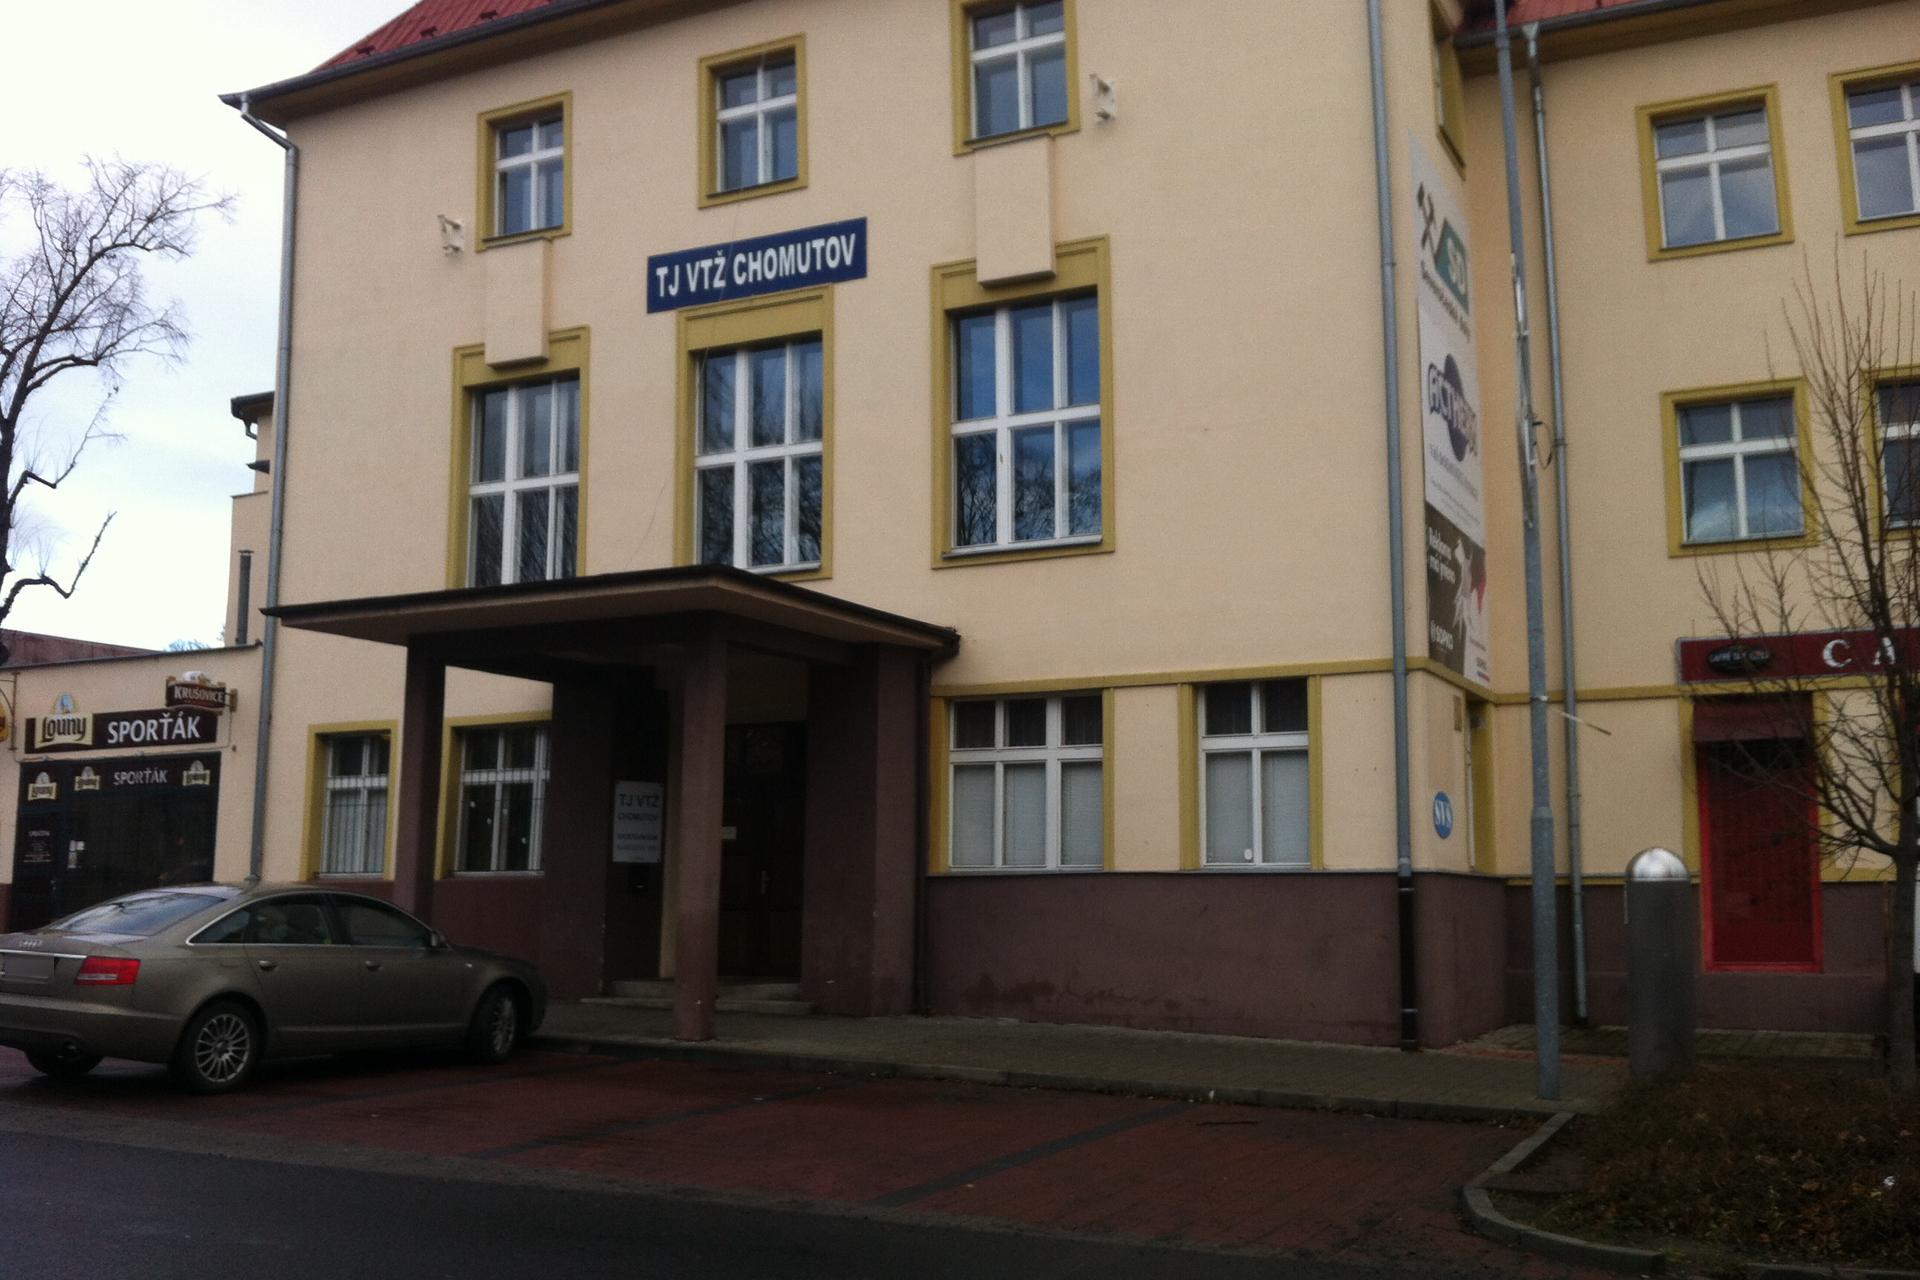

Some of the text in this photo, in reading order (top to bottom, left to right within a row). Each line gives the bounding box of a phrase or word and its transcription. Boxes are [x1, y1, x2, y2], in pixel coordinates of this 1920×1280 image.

[656, 233, 857, 298] TJ VTŽ CHOMUTOV
[107, 710, 201, 744] SPORŤÁK
[112, 766, 168, 785] SPORŤÁK
